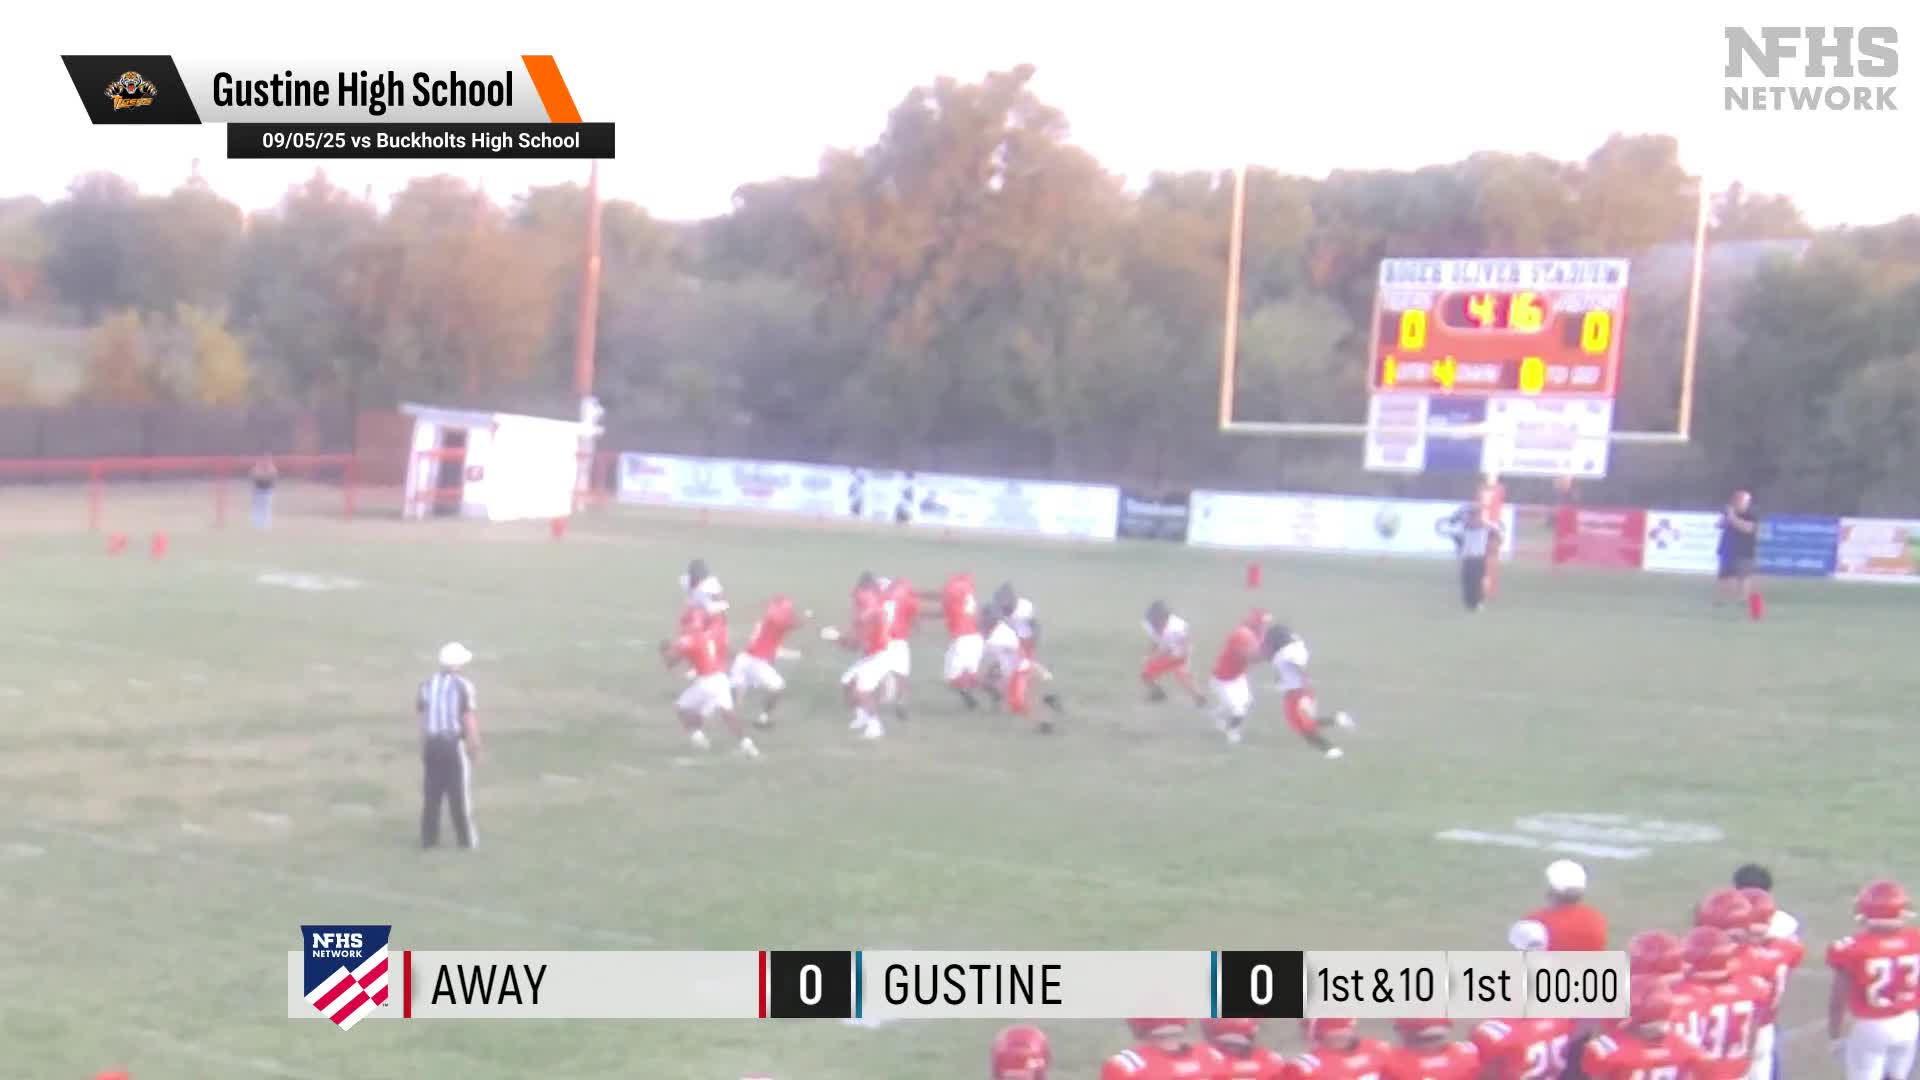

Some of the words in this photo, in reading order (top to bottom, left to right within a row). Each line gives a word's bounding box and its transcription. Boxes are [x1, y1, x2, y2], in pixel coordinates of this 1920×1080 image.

[1399, 309, 1428, 351] 0
[1581, 310, 1612, 353] 0
[1864, 956, 1920, 1008] 23
